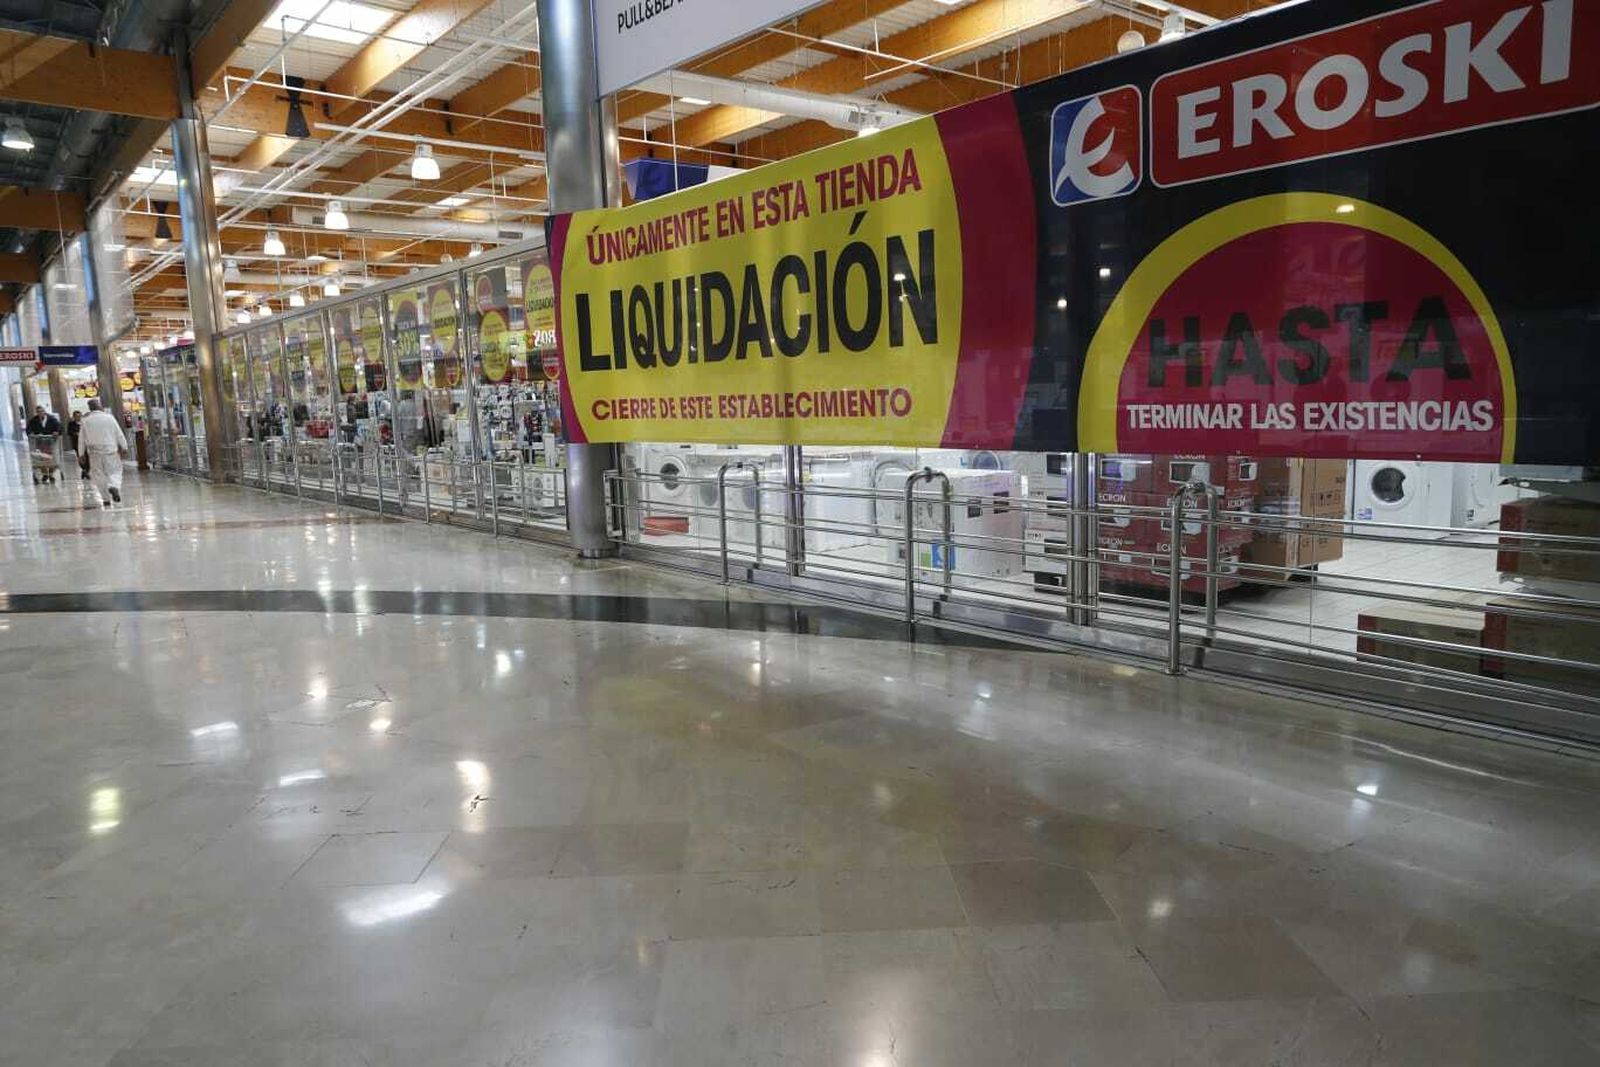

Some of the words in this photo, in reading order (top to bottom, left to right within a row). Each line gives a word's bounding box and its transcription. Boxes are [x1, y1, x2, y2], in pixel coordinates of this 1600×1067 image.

[617, 0, 684, 34] PULL&BE
[1176, 0, 1574, 160] EROSKI
[587, 206, 709, 265] ÚNICAMENTE
[717, 196, 745, 238] EN
[753, 180, 810, 230] ESTA
[815, 148, 922, 214] TIENDA
[575, 211, 939, 372] LIQUIDACIÓN
[1147, 295, 1472, 388] HASTA
[591, 399, 658, 421] CIERRE
[659, 397, 677, 419] DE
[680, 395, 713, 419] ESTE
[718, 388, 913, 419] ESTABLECIMIENTO
[1127, 404, 1243, 430] TERMINAR
[1251, 403, 1297, 430] LAS
[1303, 400, 1494, 432] EXISTENCIAS
[1166, 497, 1198, 508] EON
[1156, 542, 1187, 554] ECN
